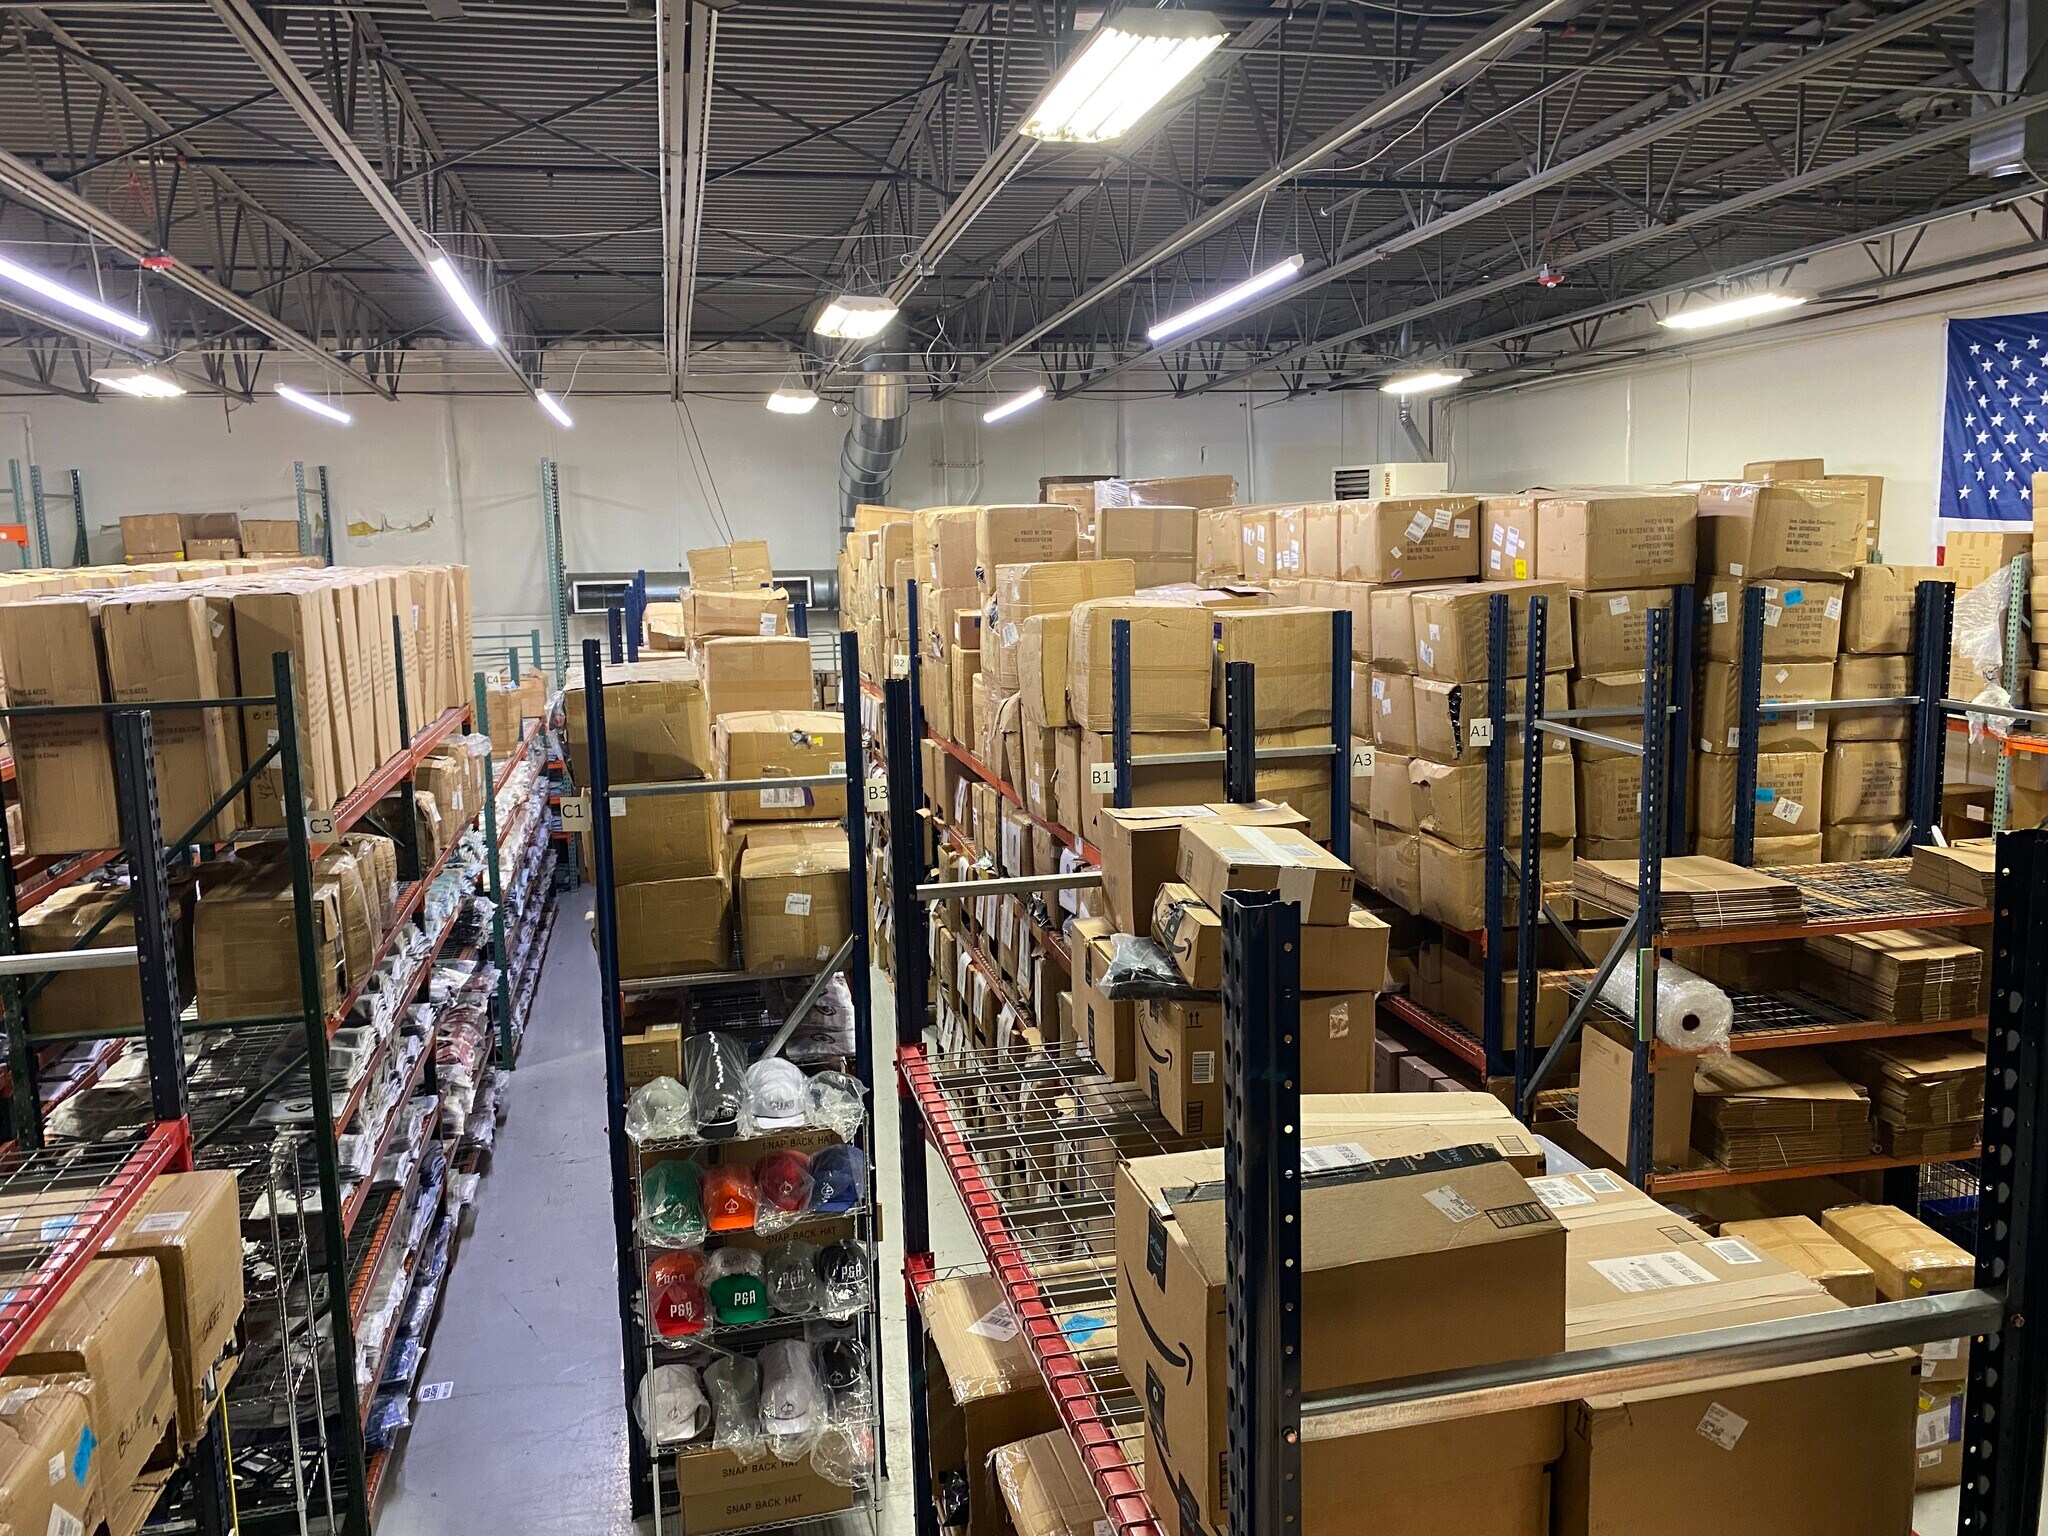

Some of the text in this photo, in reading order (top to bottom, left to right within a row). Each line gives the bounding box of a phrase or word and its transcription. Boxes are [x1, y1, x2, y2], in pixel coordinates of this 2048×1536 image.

[894, 659, 904, 667] B2
[487, 676, 498, 684] C4
[1471, 725, 1488, 737] A1
[1353, 753, 1372, 766] A3
[1093, 770, 1110, 784] B1
[869, 785, 888, 799] B3
[562, 804, 584, 818] C1
[310, 819, 332, 834] C3
[763, 1134, 834, 1150] SNAP BACK HAT
[766, 1227, 837, 1244] SNAP BACK HAT
[842, 1264, 862, 1279] P&A
[734, 1290, 756, 1306] P&A
[670, 1302, 692, 1318] P&A
[117, 1406, 142, 1460] BLUE
[722, 1466, 748, 1478] SNAP
[752, 1462, 777, 1472] BACK
[726, 1494, 803, 1515] SNAP BACK HAT
